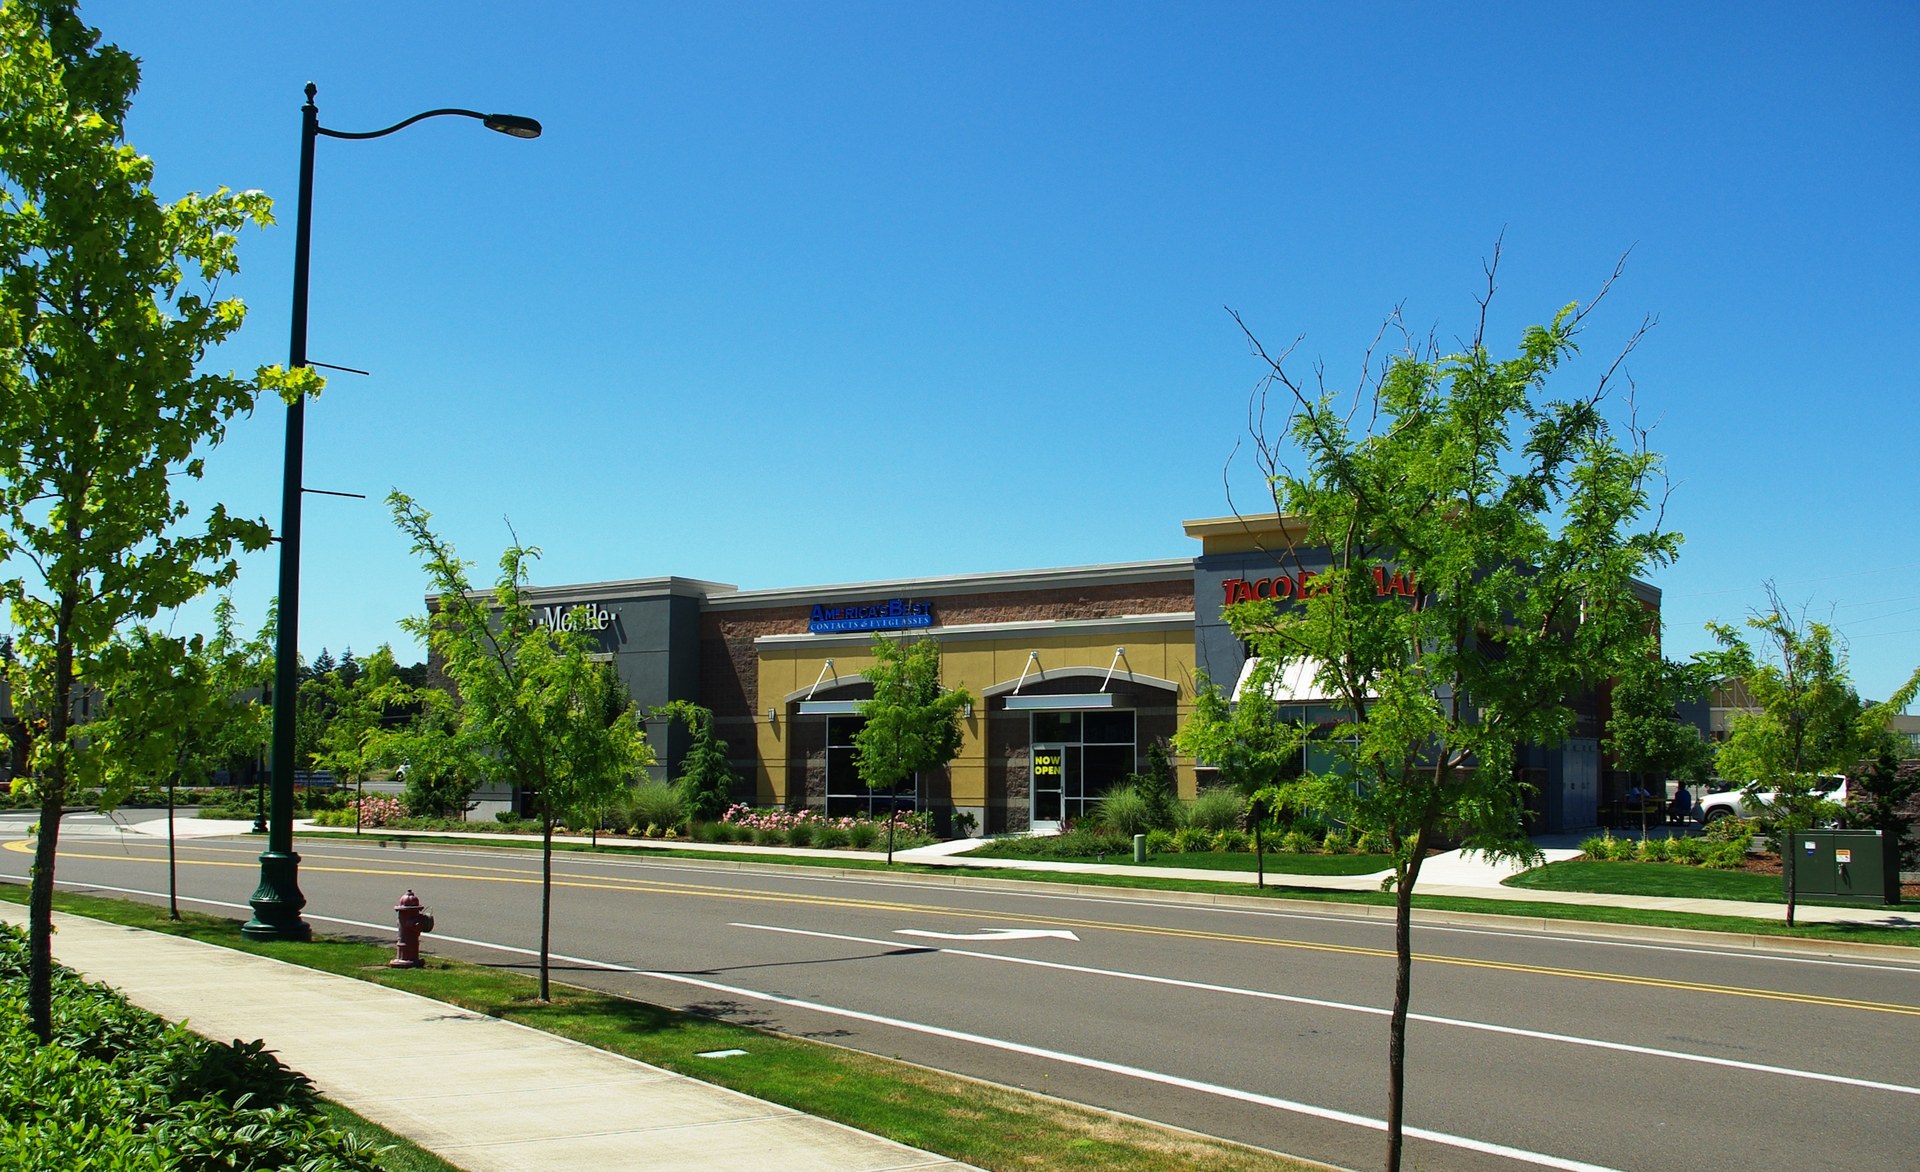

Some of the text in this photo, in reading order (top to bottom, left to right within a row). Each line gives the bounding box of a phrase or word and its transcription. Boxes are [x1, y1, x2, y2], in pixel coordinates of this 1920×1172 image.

[1222, 575, 1292, 605] TACO
[810, 617, 929, 631] CONTACTS & EYEGLASSES
[1035, 756, 1060, 765] NOW
[1035, 766, 1061, 775] OPEN
